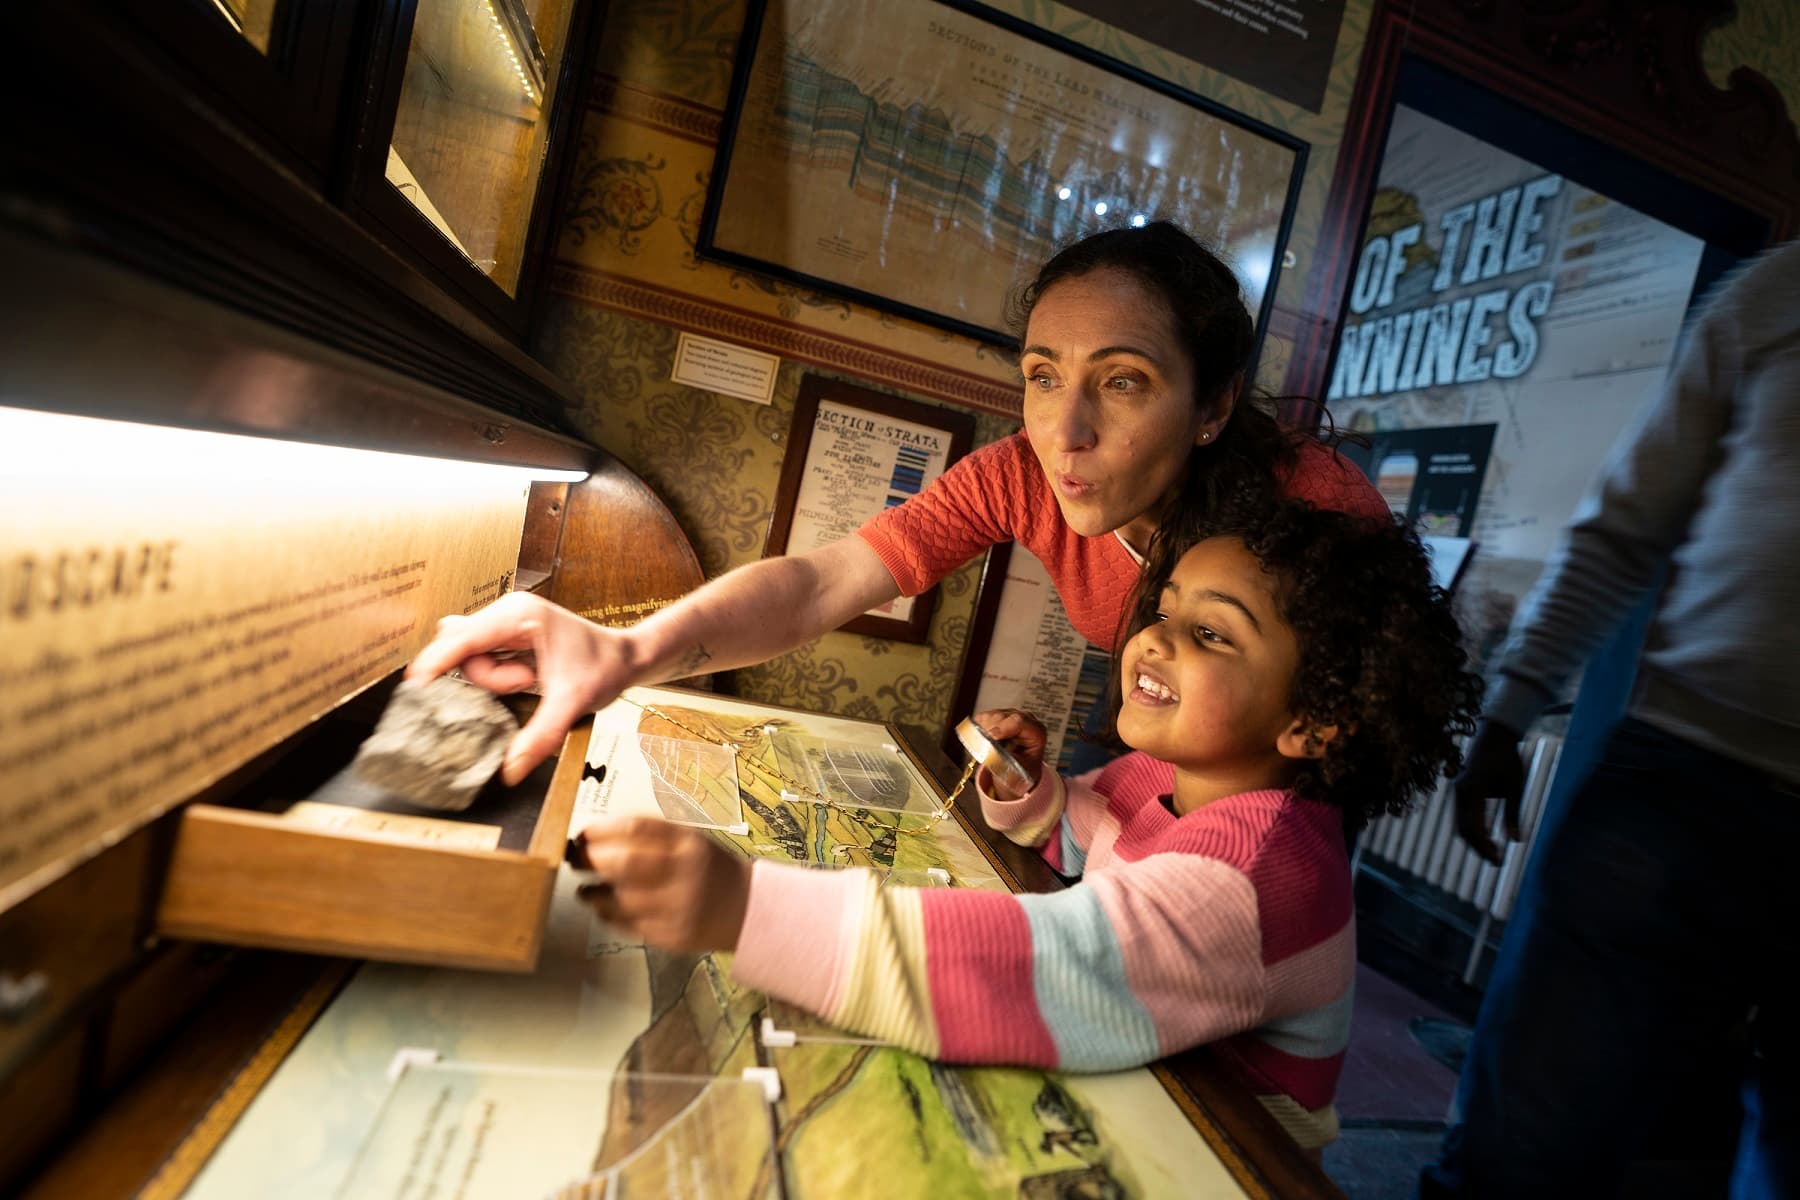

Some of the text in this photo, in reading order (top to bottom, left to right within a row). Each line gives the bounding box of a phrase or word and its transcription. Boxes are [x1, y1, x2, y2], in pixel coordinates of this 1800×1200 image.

[1350, 225, 1421, 313] OF
[1433, 174, 1564, 292] THE
[1327, 281, 1554, 400] NNINES
[885, 426, 939, 449] STRATA
[605, 603, 620, 615] the
